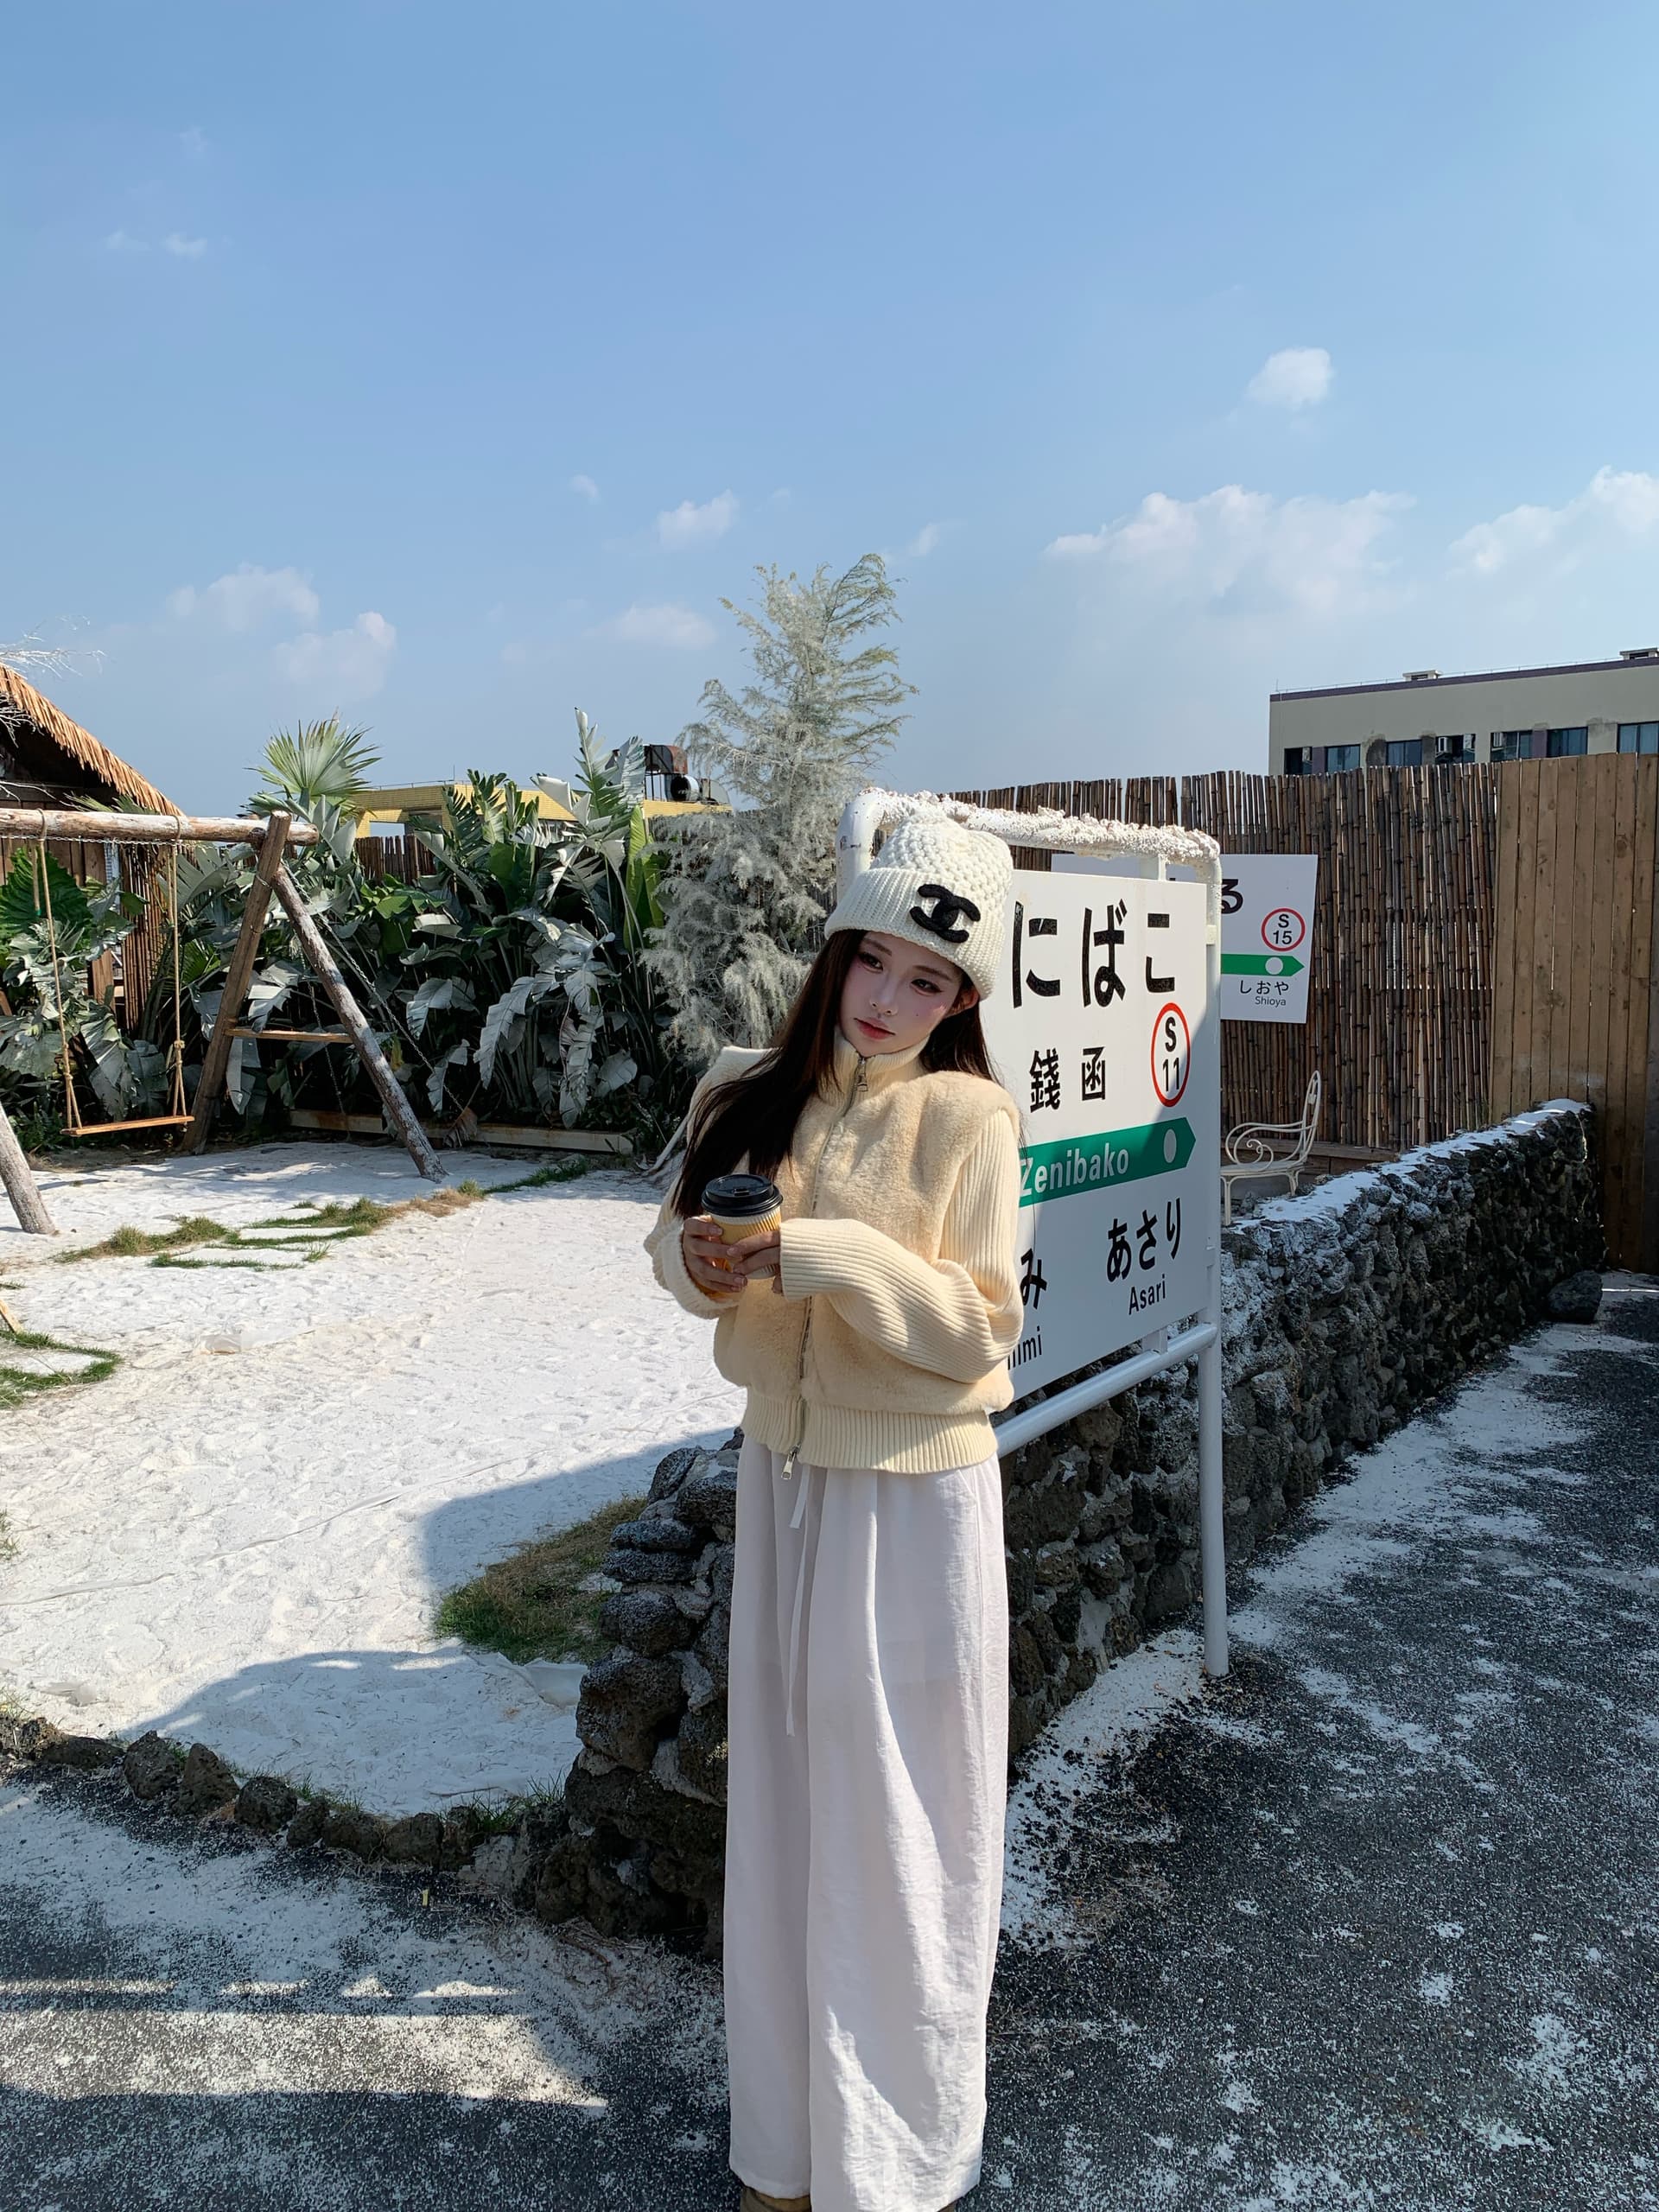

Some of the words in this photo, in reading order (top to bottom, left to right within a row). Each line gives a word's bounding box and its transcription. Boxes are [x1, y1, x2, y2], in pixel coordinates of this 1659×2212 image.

[1272, 930, 1293, 945] 15
[1277, 913, 1290, 929] S
[1013, 899, 1175, 1008] にばこ
[1239, 980, 1289, 995] しおや
[1255, 995, 1287, 1007] Shioya
[1165, 1016, 1177, 1052] S
[1162, 1058, 1180, 1092] 11
[1020, 1142, 1129, 1198] Zenibako
[1107, 1198, 1180, 1283] あさり
[1020, 1248, 1047, 1310] み
[1128, 1274, 1166, 1315] Asari
